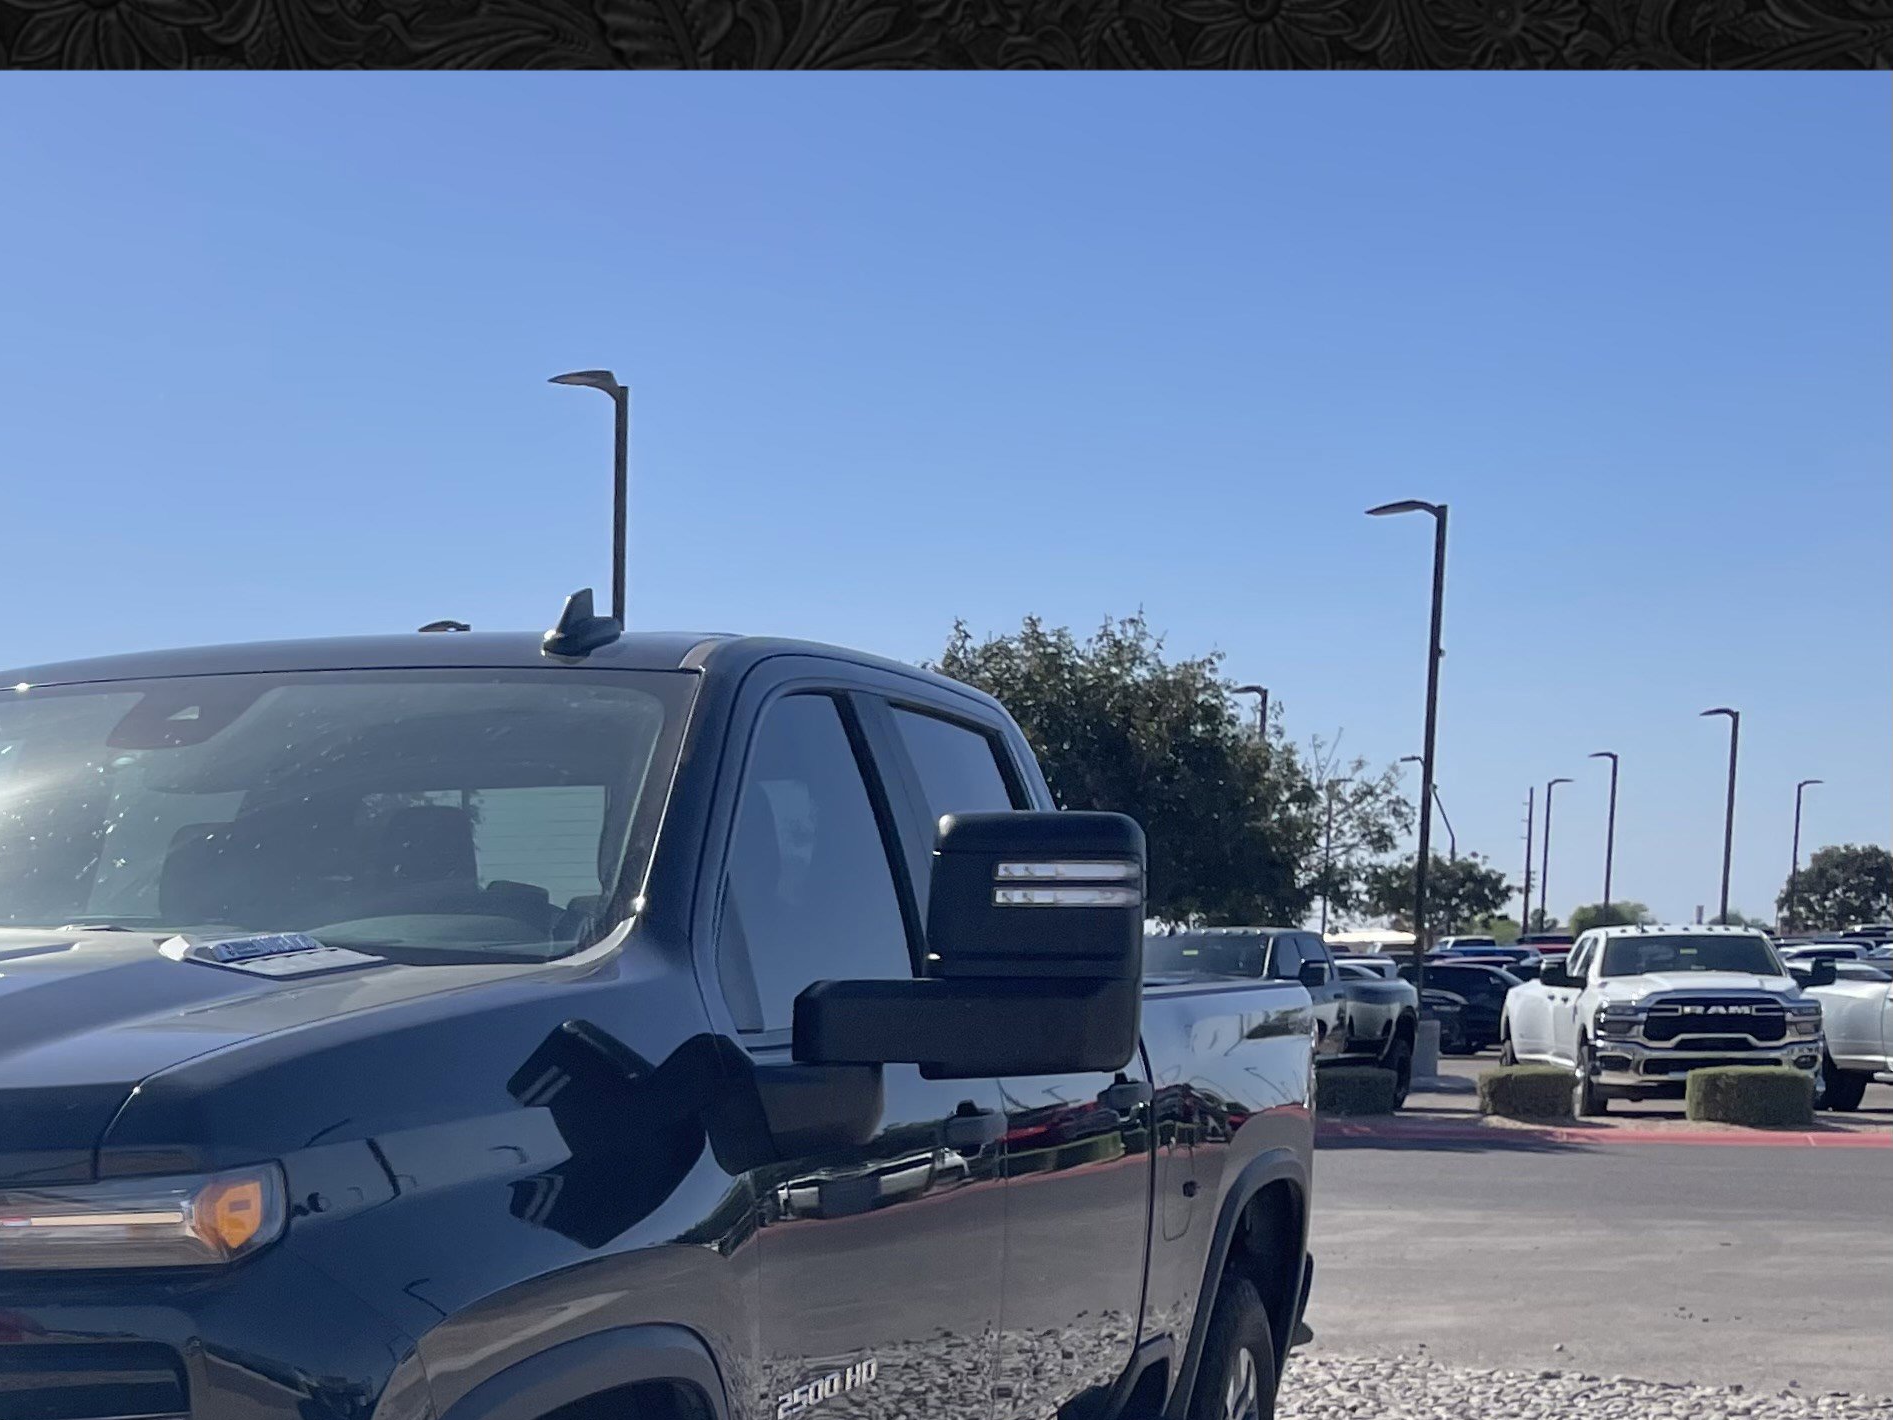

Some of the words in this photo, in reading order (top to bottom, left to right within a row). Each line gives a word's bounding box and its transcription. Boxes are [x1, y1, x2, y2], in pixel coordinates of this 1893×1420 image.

[1682, 1005, 1751, 1015] RAM
[777, 1371, 842, 1420] 2500
[845, 1357, 877, 1392] HD
